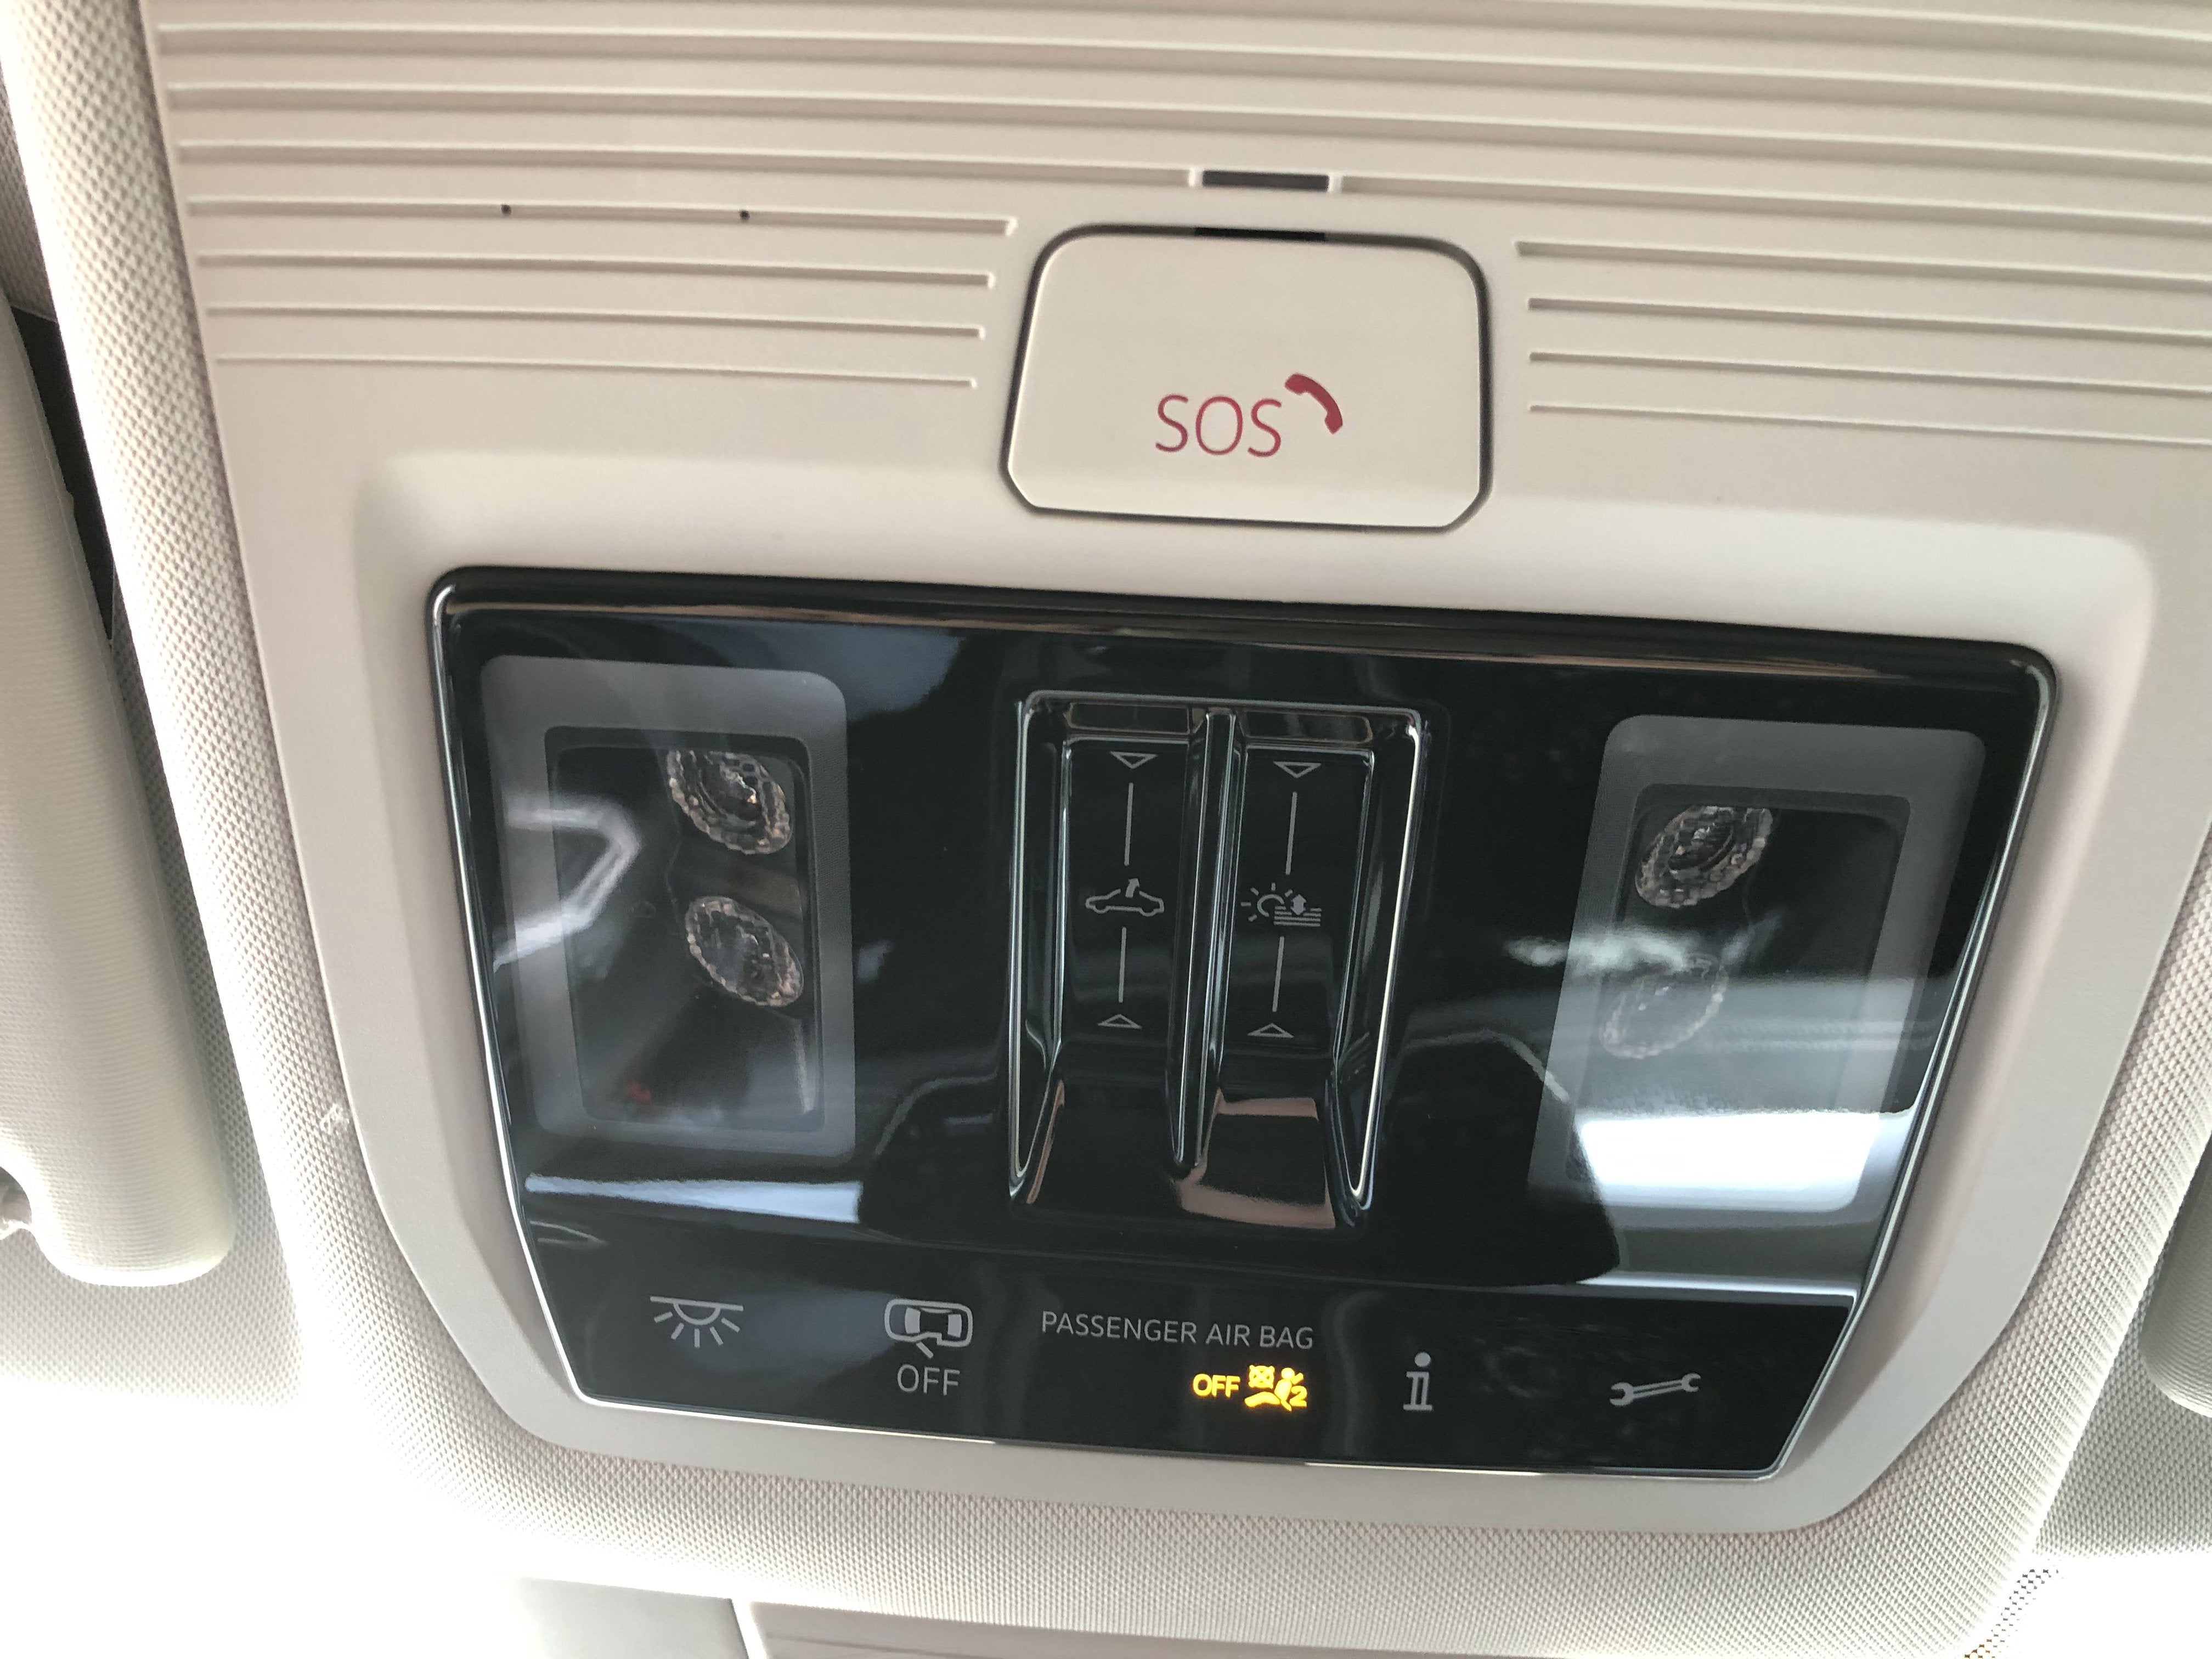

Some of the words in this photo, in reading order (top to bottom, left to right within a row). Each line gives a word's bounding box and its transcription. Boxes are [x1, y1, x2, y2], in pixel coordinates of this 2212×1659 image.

[1155, 393, 1282, 458] SOS
[1041, 1311, 1197, 1344] PASSENGER
[1205, 1323, 1251, 1347] AIR
[1259, 1325, 1314, 1350] BAG
[897, 1363, 960, 1396] OFF
[1192, 1373, 1241, 1398] OFF
